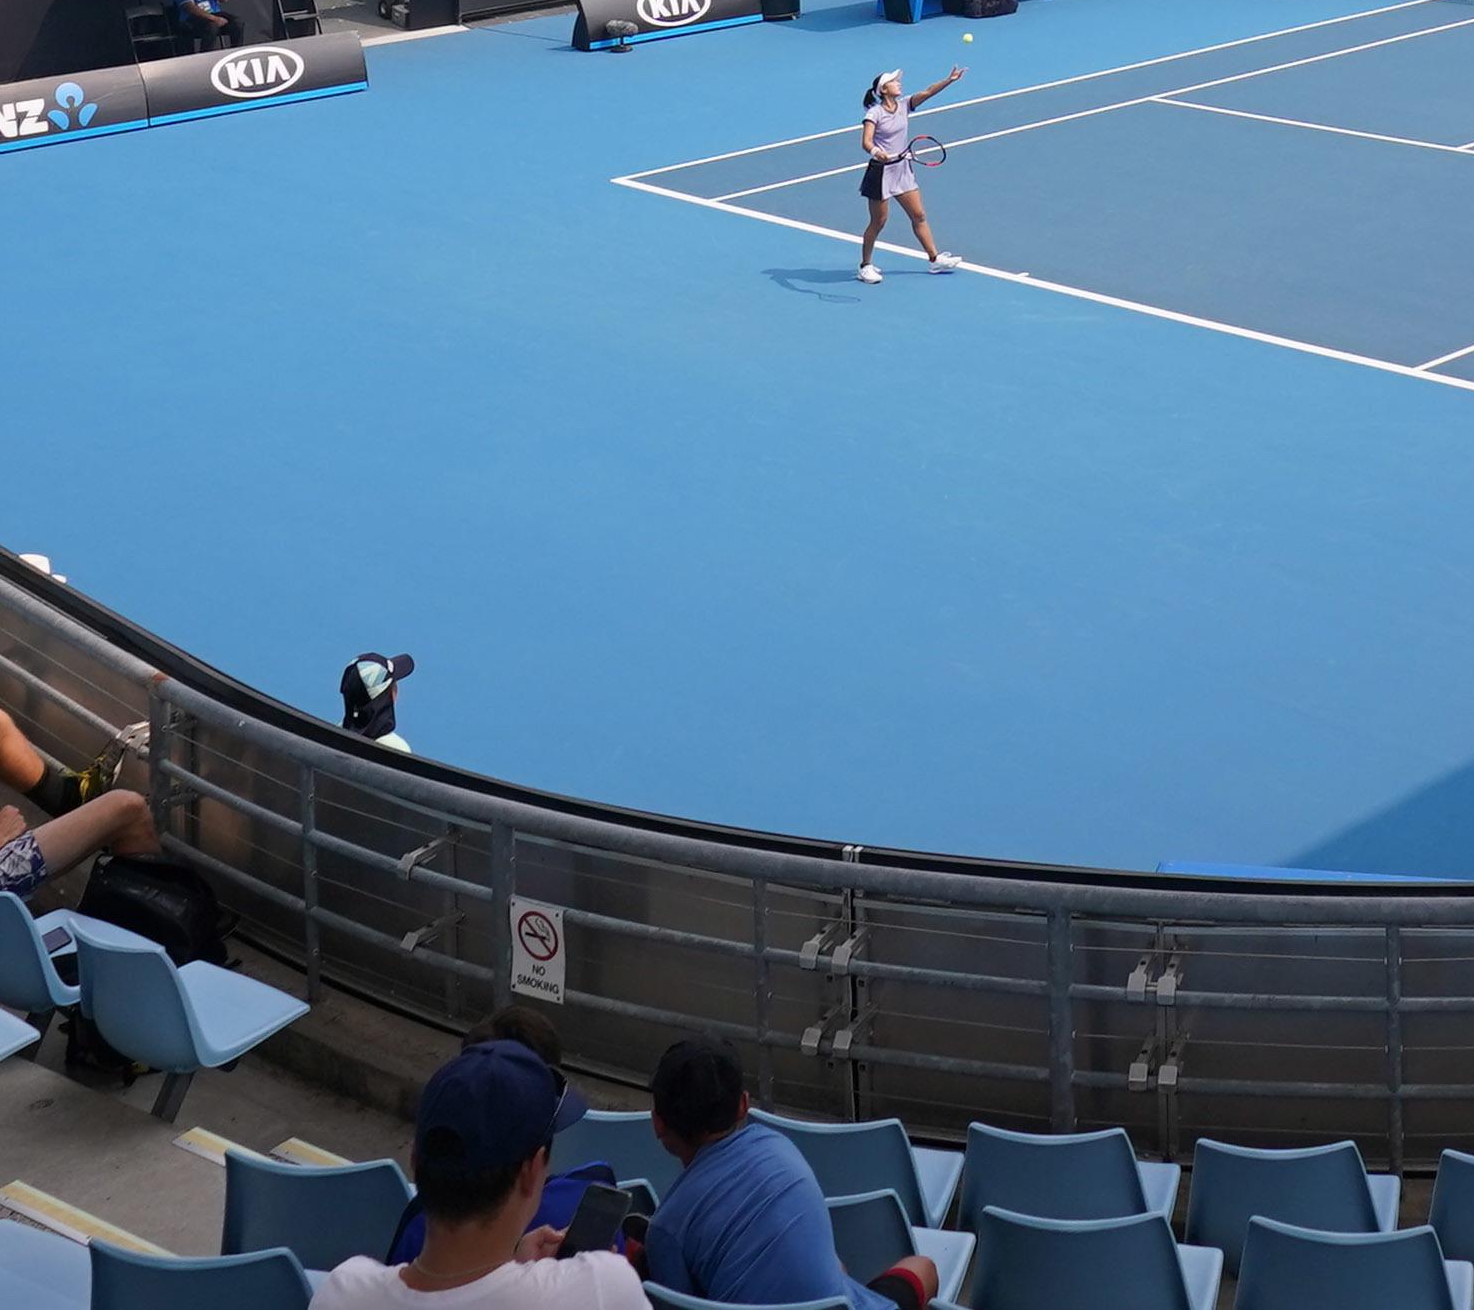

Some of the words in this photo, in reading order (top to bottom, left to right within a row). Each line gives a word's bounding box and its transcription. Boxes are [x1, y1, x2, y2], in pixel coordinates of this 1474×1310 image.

[225, 54, 291, 89] KIA
[532, 964, 546, 976] NO
[517, 974, 559, 994] SMOKING
